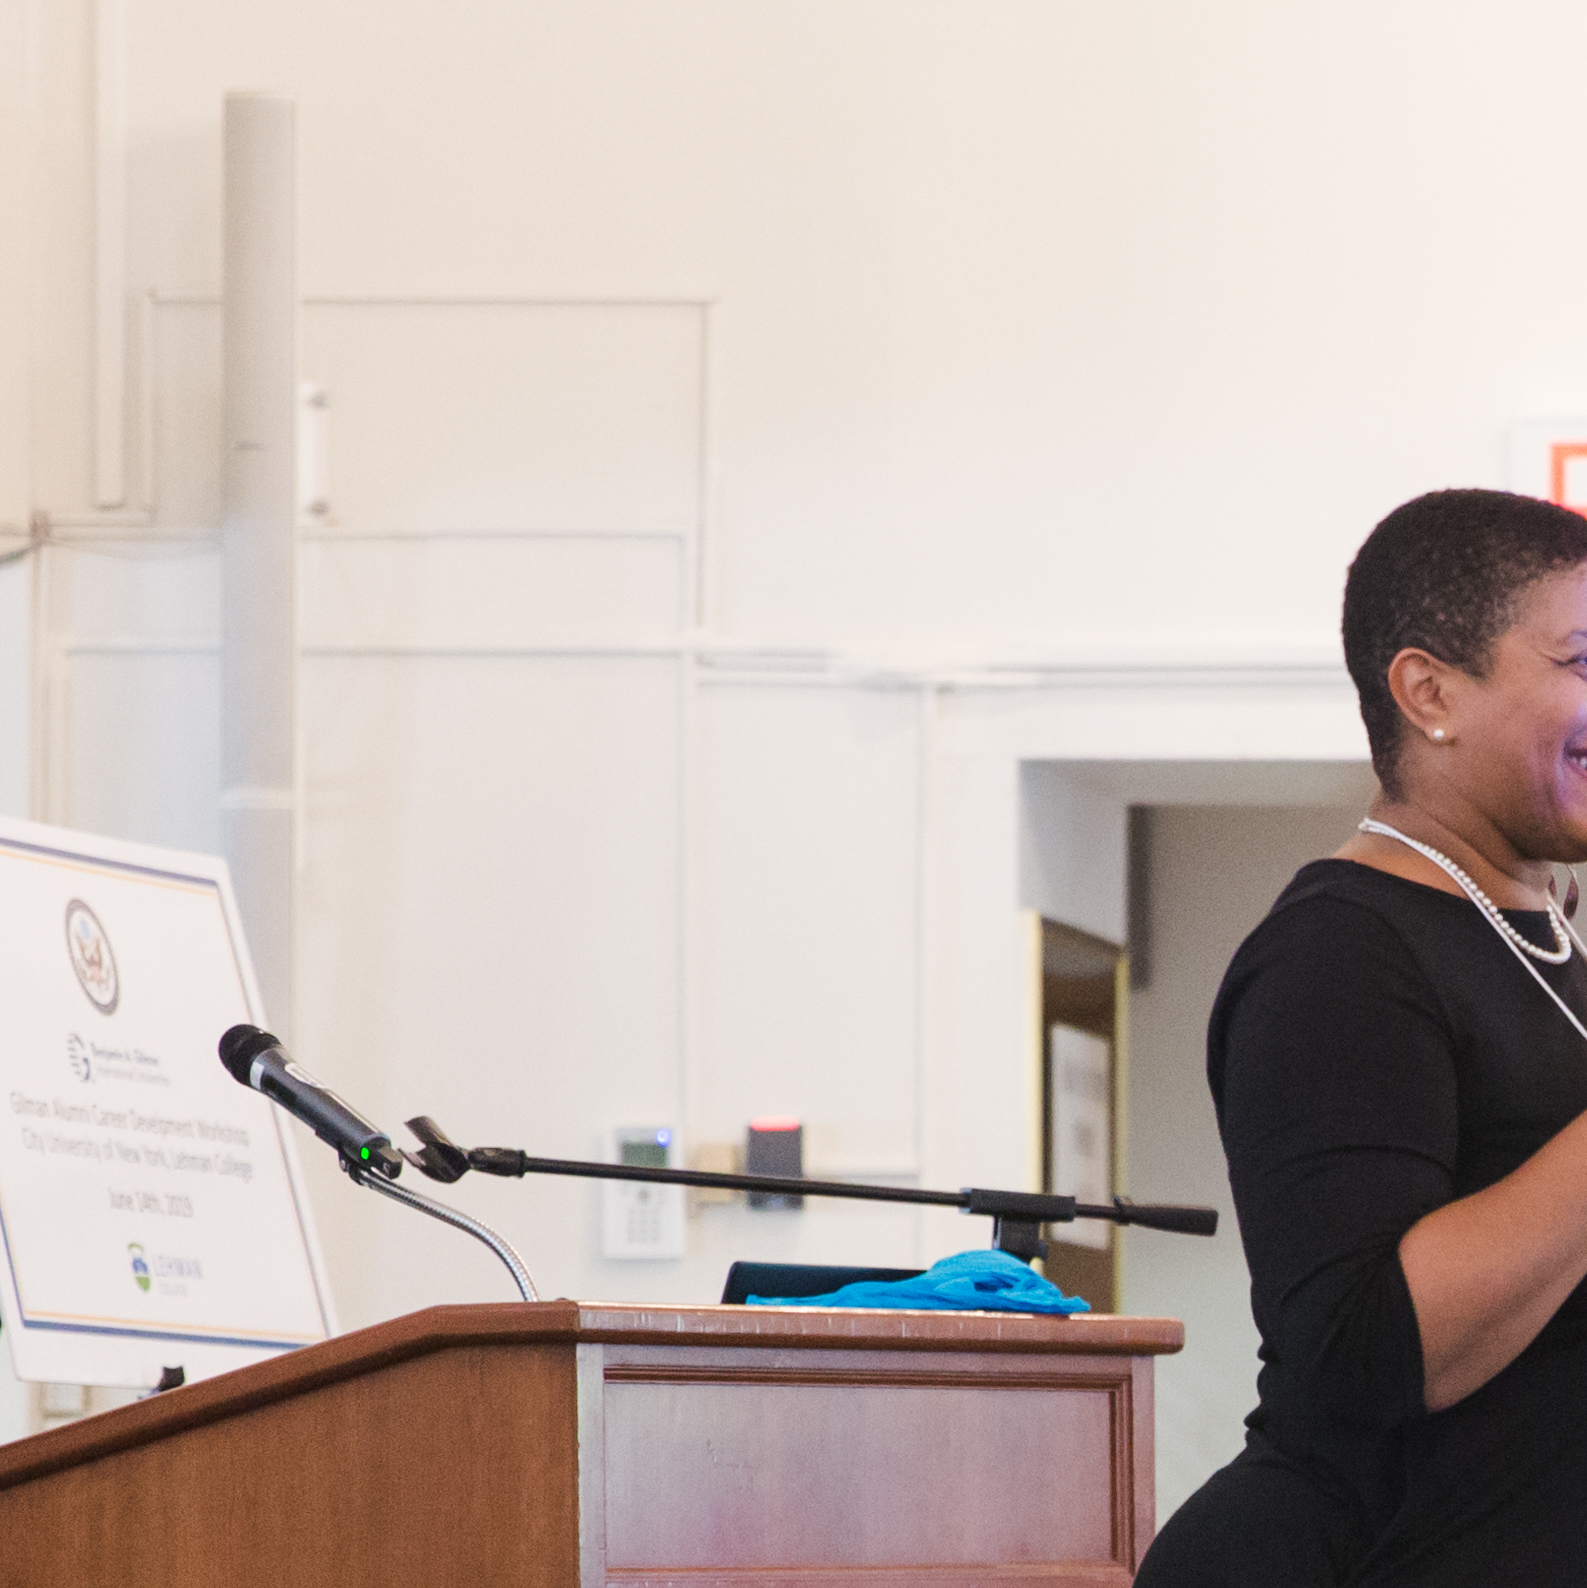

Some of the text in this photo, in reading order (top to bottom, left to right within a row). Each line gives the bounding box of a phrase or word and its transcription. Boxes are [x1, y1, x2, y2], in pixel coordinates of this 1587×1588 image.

[10, 1091, 249, 1147] Gilman Alumni Career Development Workshop
[21, 1127, 45, 1156] City
[45, 1133, 102, 1162] University
[114, 1141, 141, 1163] New
[170, 1148, 213, 1172] Lehman
[214, 1153, 253, 1183] College
[108, 1186, 134, 1211] June
[151, 1254, 202, 1279] LEHMAN
